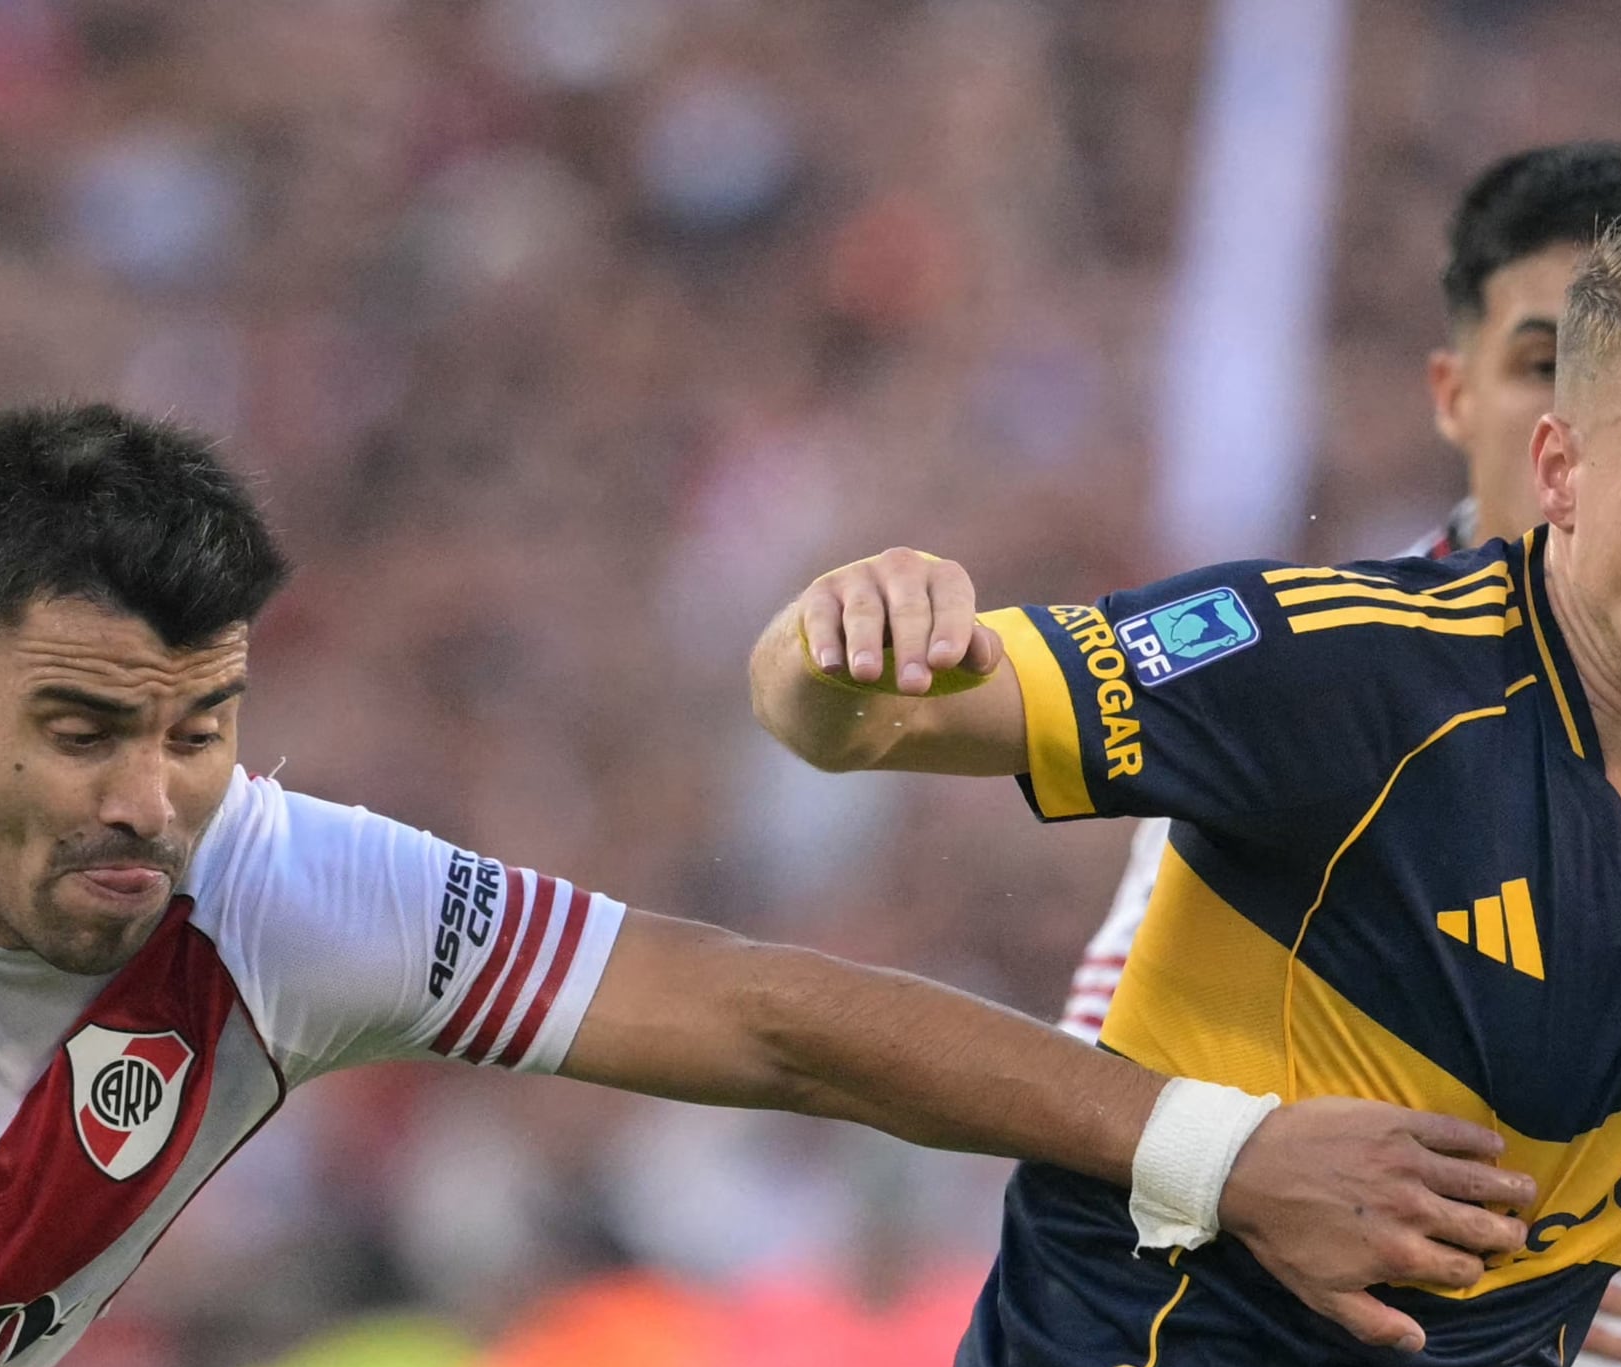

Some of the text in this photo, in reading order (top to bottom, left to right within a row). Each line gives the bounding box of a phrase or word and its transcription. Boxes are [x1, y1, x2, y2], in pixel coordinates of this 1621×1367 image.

[1119, 618, 1172, 677] LPF
[429, 849, 475, 999] ASSIST
[91, 1059, 163, 1128] CARP
